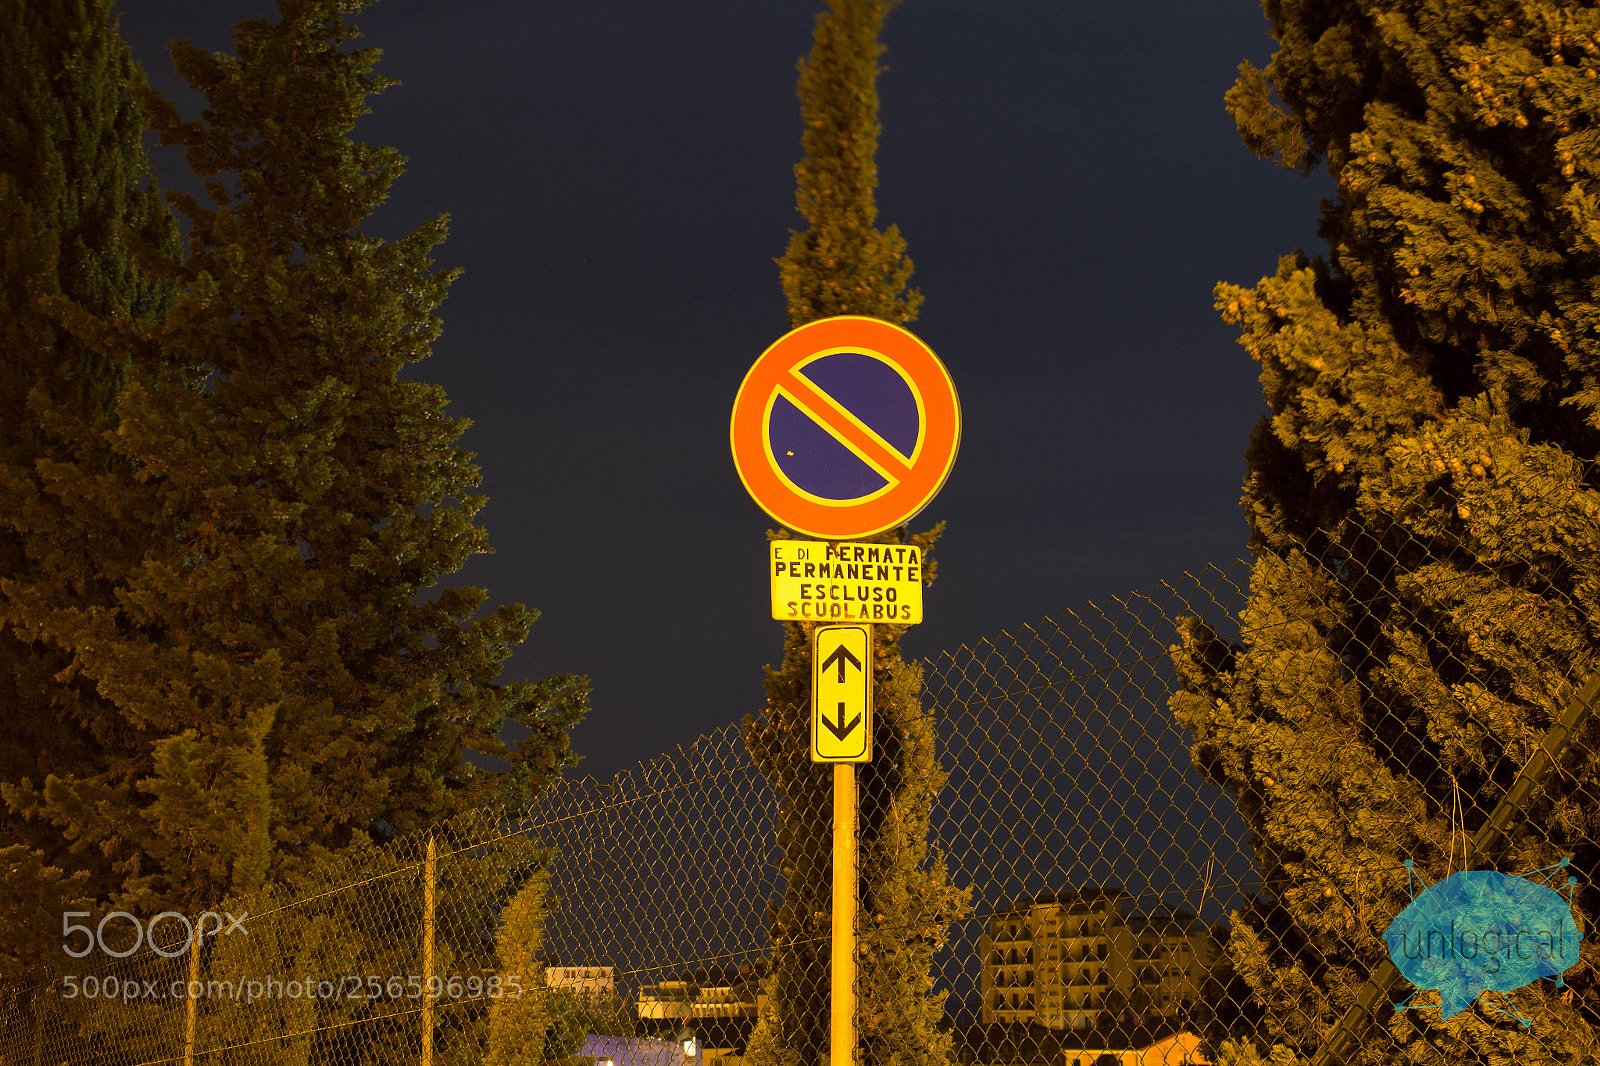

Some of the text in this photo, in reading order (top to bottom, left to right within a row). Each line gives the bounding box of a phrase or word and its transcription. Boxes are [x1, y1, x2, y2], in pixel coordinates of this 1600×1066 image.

[774, 545, 919, 565] E DI FERMATA
[775, 561, 919, 583] PERMANENTE
[800, 583, 897, 602] ESCLUSO
[787, 601, 912, 620] SCUOLABUS
